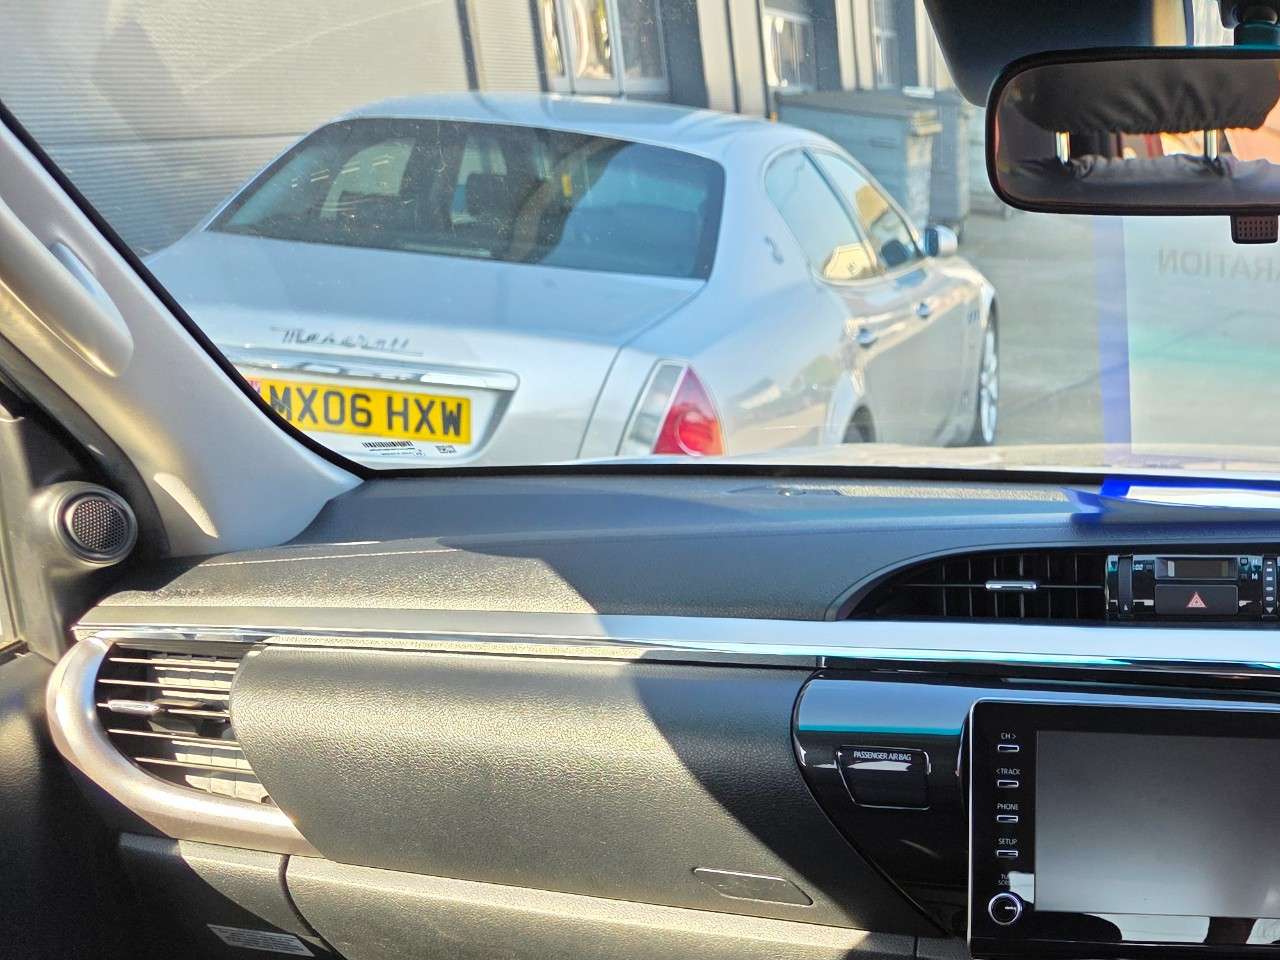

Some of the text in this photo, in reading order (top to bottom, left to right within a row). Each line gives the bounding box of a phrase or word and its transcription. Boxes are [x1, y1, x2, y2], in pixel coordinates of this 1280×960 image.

[268, 384, 462, 437] MX06 HXW
[853, 750, 888, 760] PASSENGER
[1000, 768, 1021, 776] TRACK
[996, 803, 1019, 811] PHONE
